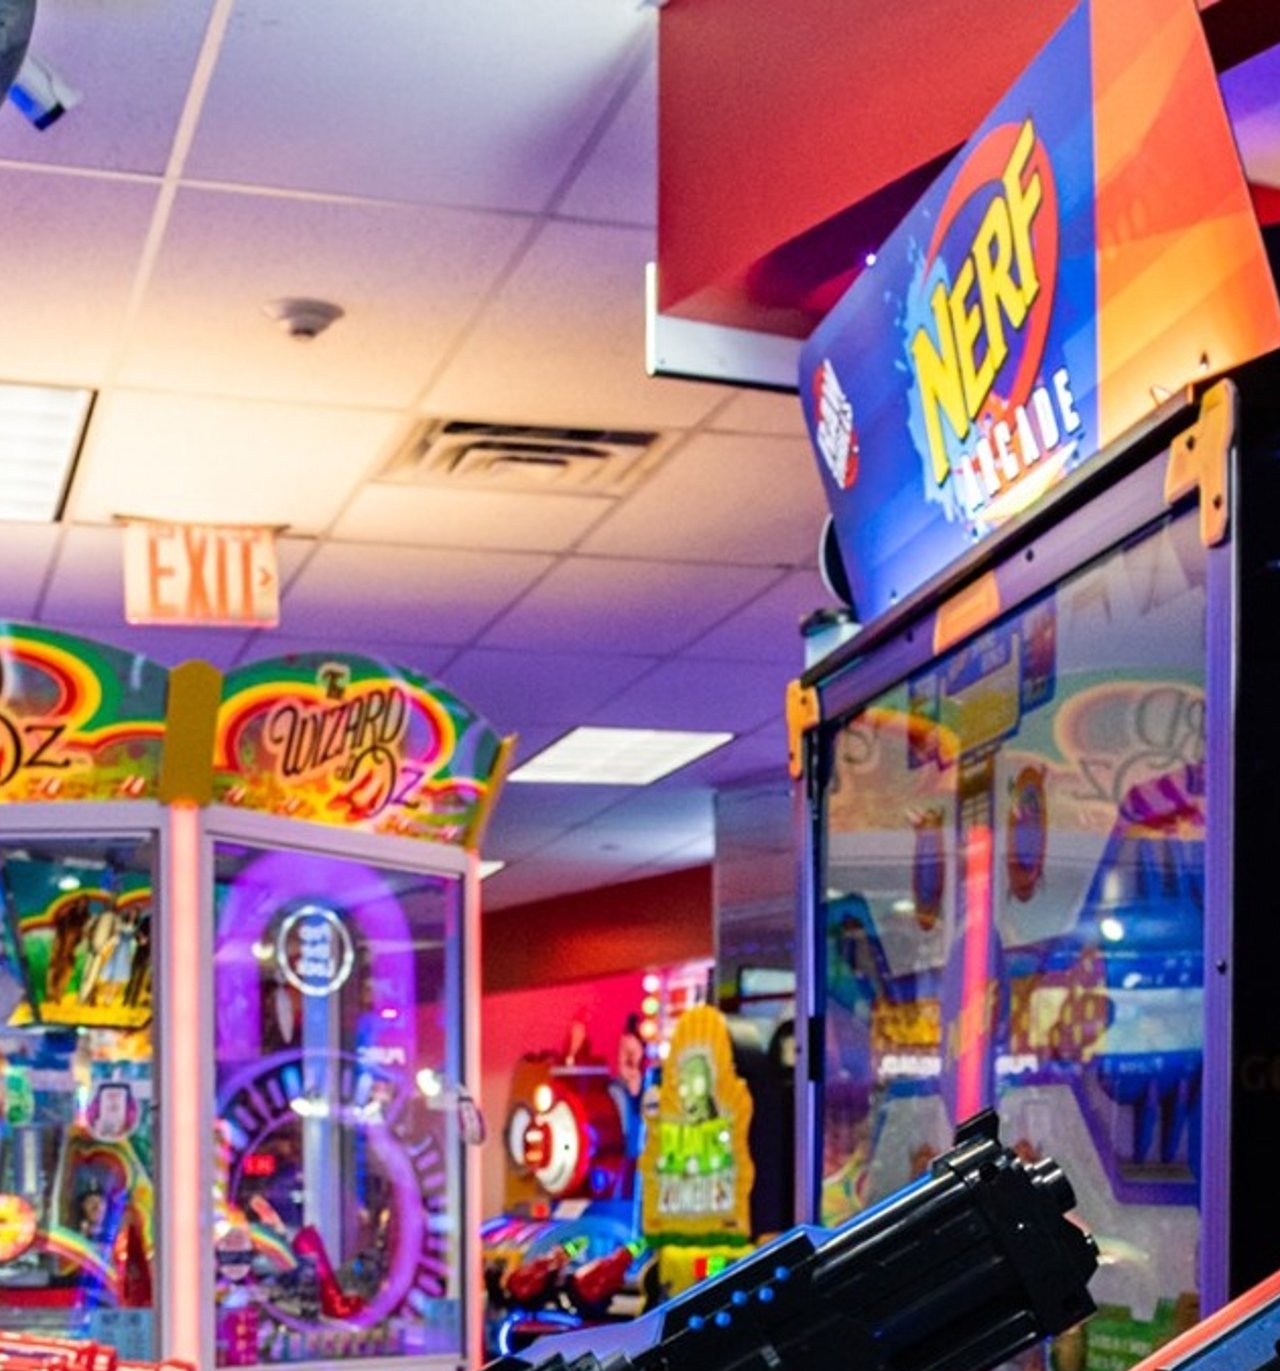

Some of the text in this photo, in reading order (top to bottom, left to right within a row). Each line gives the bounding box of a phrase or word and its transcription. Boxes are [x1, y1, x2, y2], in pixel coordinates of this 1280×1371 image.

[911, 118, 1043, 487] NERF
[959, 365, 1082, 508] ARCADE
[147, 522, 262, 621] EXIT
[270, 686, 408, 777] WIZARD
